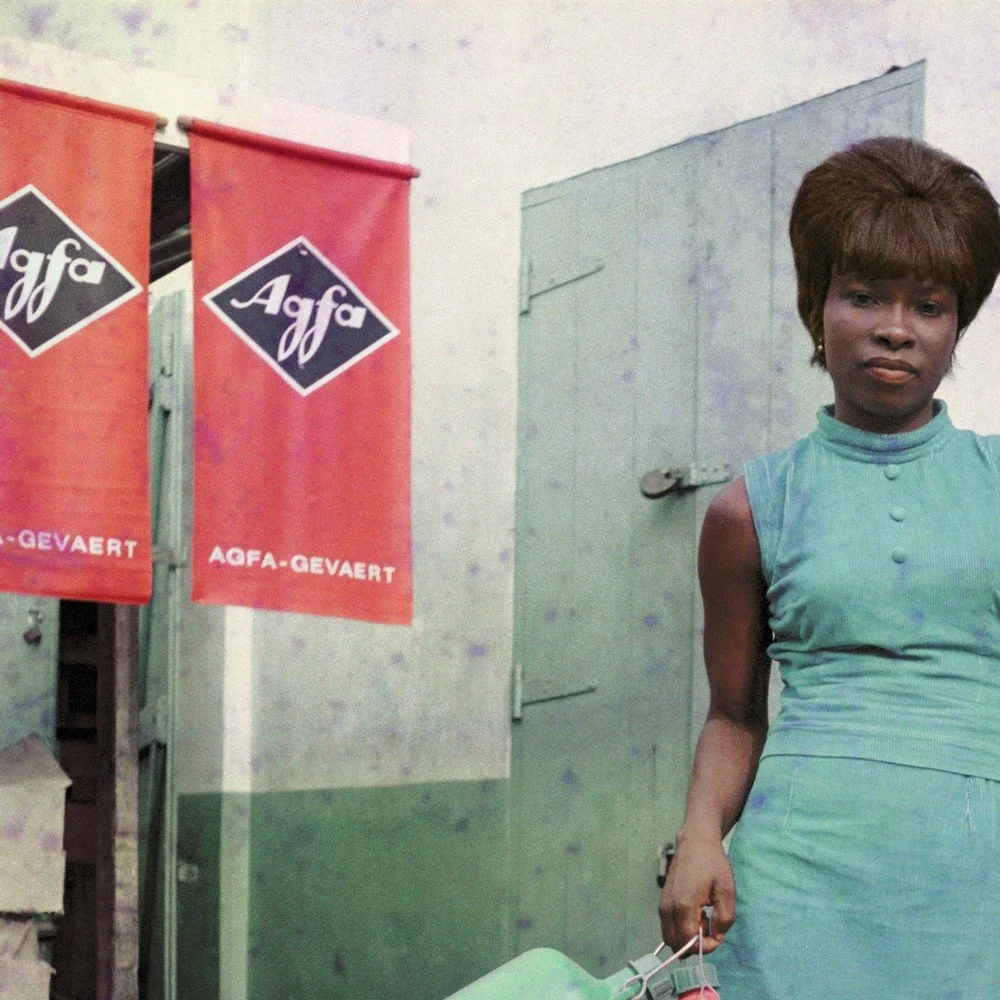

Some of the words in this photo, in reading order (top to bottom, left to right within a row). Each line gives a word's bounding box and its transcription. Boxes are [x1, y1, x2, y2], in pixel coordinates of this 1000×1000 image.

[231, 274, 366, 365] Agfa
[0, 529, 138, 559] -GEVAERT
[208, 545, 396, 584] AGFA-GEVAERT
